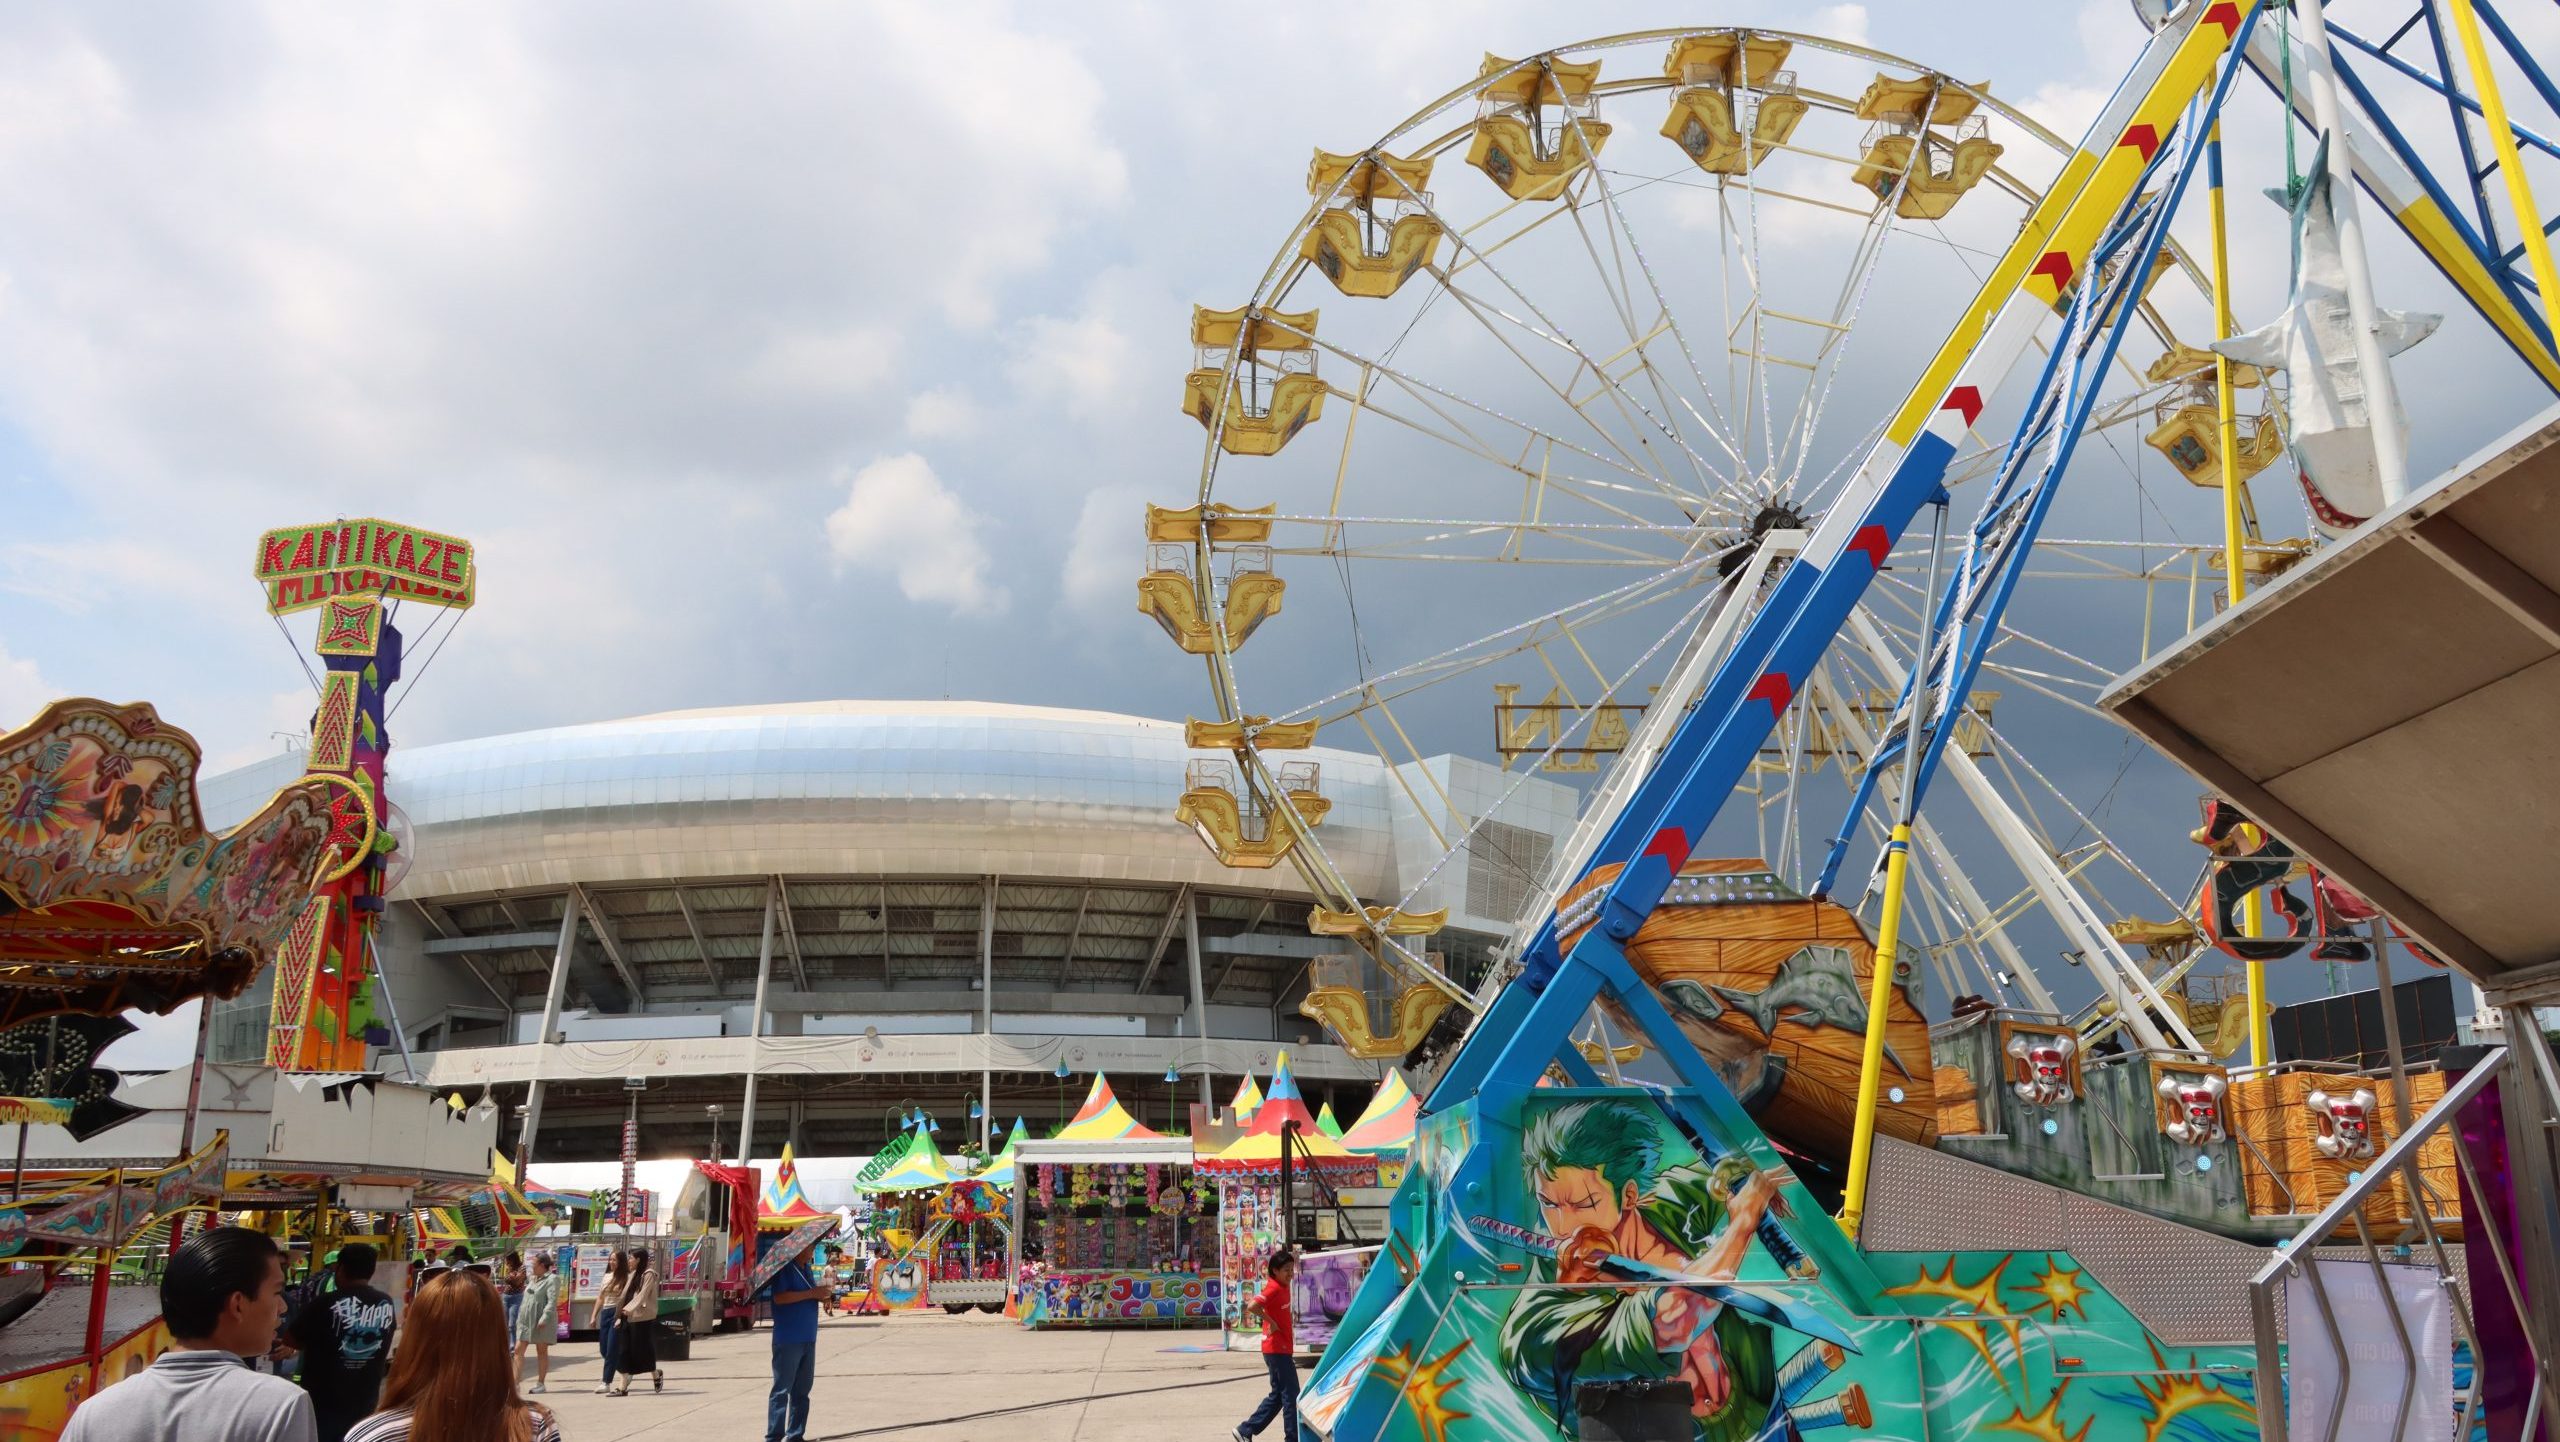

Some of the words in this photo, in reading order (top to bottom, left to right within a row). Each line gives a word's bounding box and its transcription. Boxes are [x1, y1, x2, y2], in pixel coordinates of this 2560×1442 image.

[262, 525, 466, 584] KAMIKAZE
[1109, 1277, 1202, 1301] JUEGO
[1206, 1280, 1221, 1298] D
[330, 1296, 362, 1318] BE
[343, 1303, 393, 1329] HAPPY
